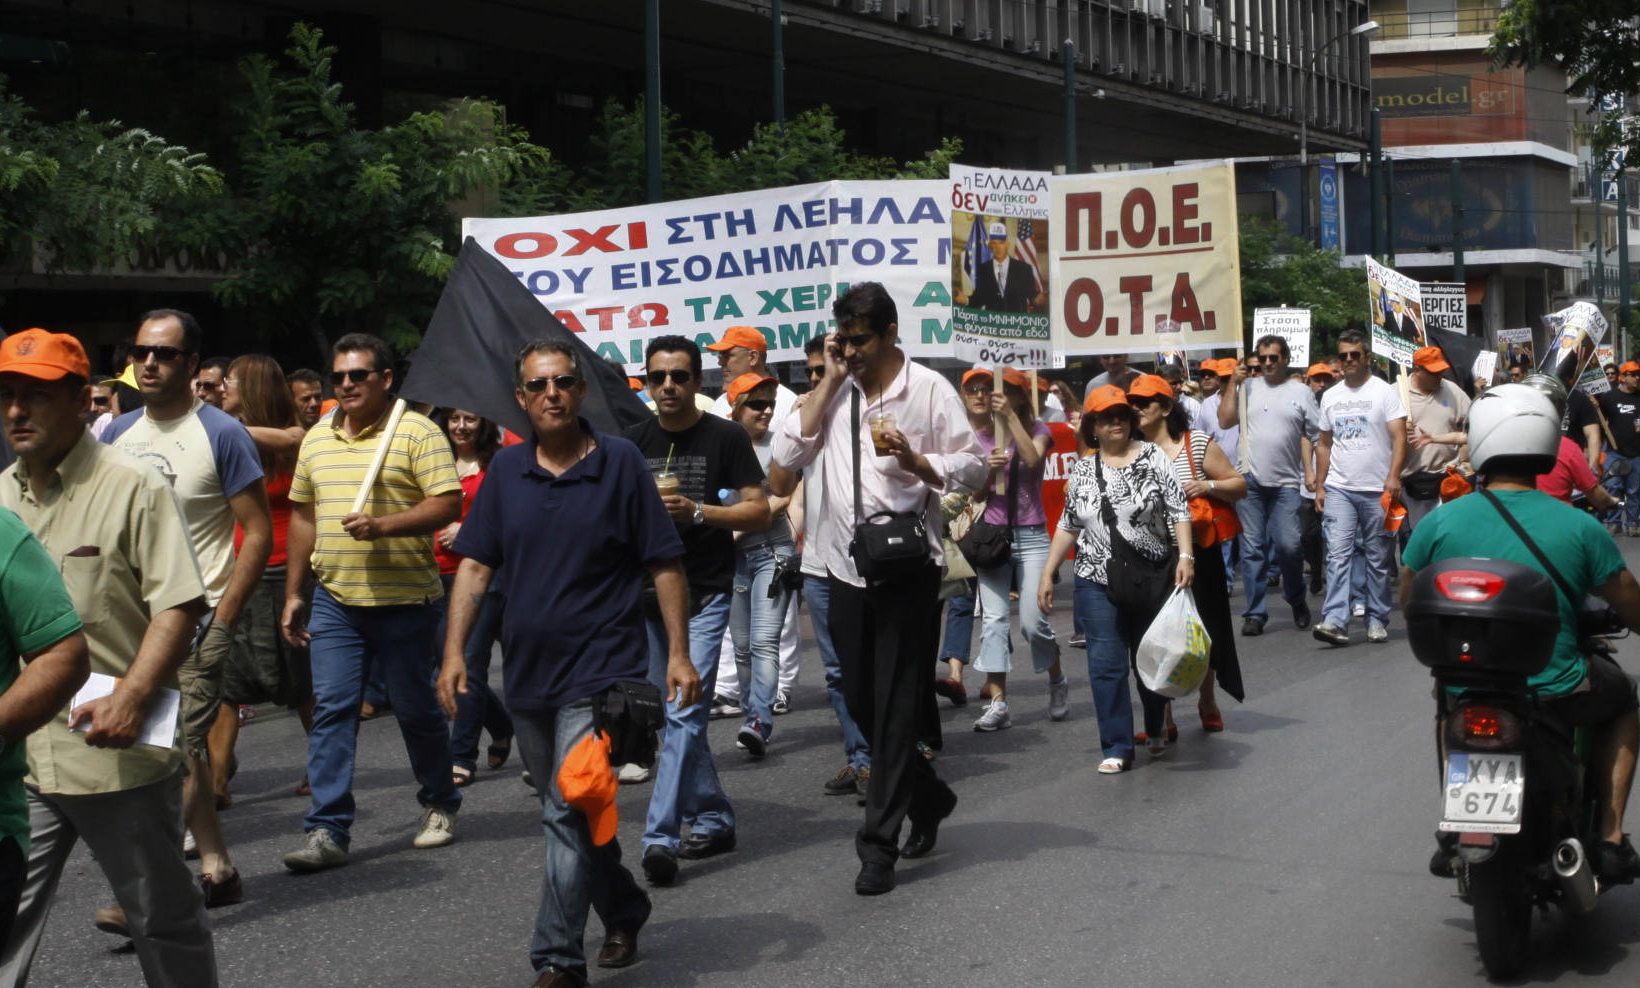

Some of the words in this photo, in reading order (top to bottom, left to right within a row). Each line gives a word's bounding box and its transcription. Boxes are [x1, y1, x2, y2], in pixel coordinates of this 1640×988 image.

[951, 183, 989, 212] δεν
[974, 172, 1049, 192] ΕΛΛΑΔΑ
[494, 221, 648, 259] ΟΧΙ
[664, 209, 756, 245] ΣΤΗ
[773, 196, 948, 231] ΛΕΗΛΑ
[1065, 182, 1212, 251] Π.Ο.Ε.
[512, 266, 594, 296] ΟΥ
[611, 237, 918, 291] ΕΙΣΟΔΗΜΑΤΟΣ
[554, 303, 669, 333] ΑΤΩ
[684, 294, 744, 322] ΤΑ
[756, 281, 868, 315] ΧΕΡΙ
[912, 281, 951, 307] Α
[989, 314, 1049, 328] ΜΝΗΜΟΝΙΟ
[1063, 272, 1217, 338] Ο.Τ.Α.
[921, 319, 951, 344] Μ
[1465, 792, 1517, 815] 674
